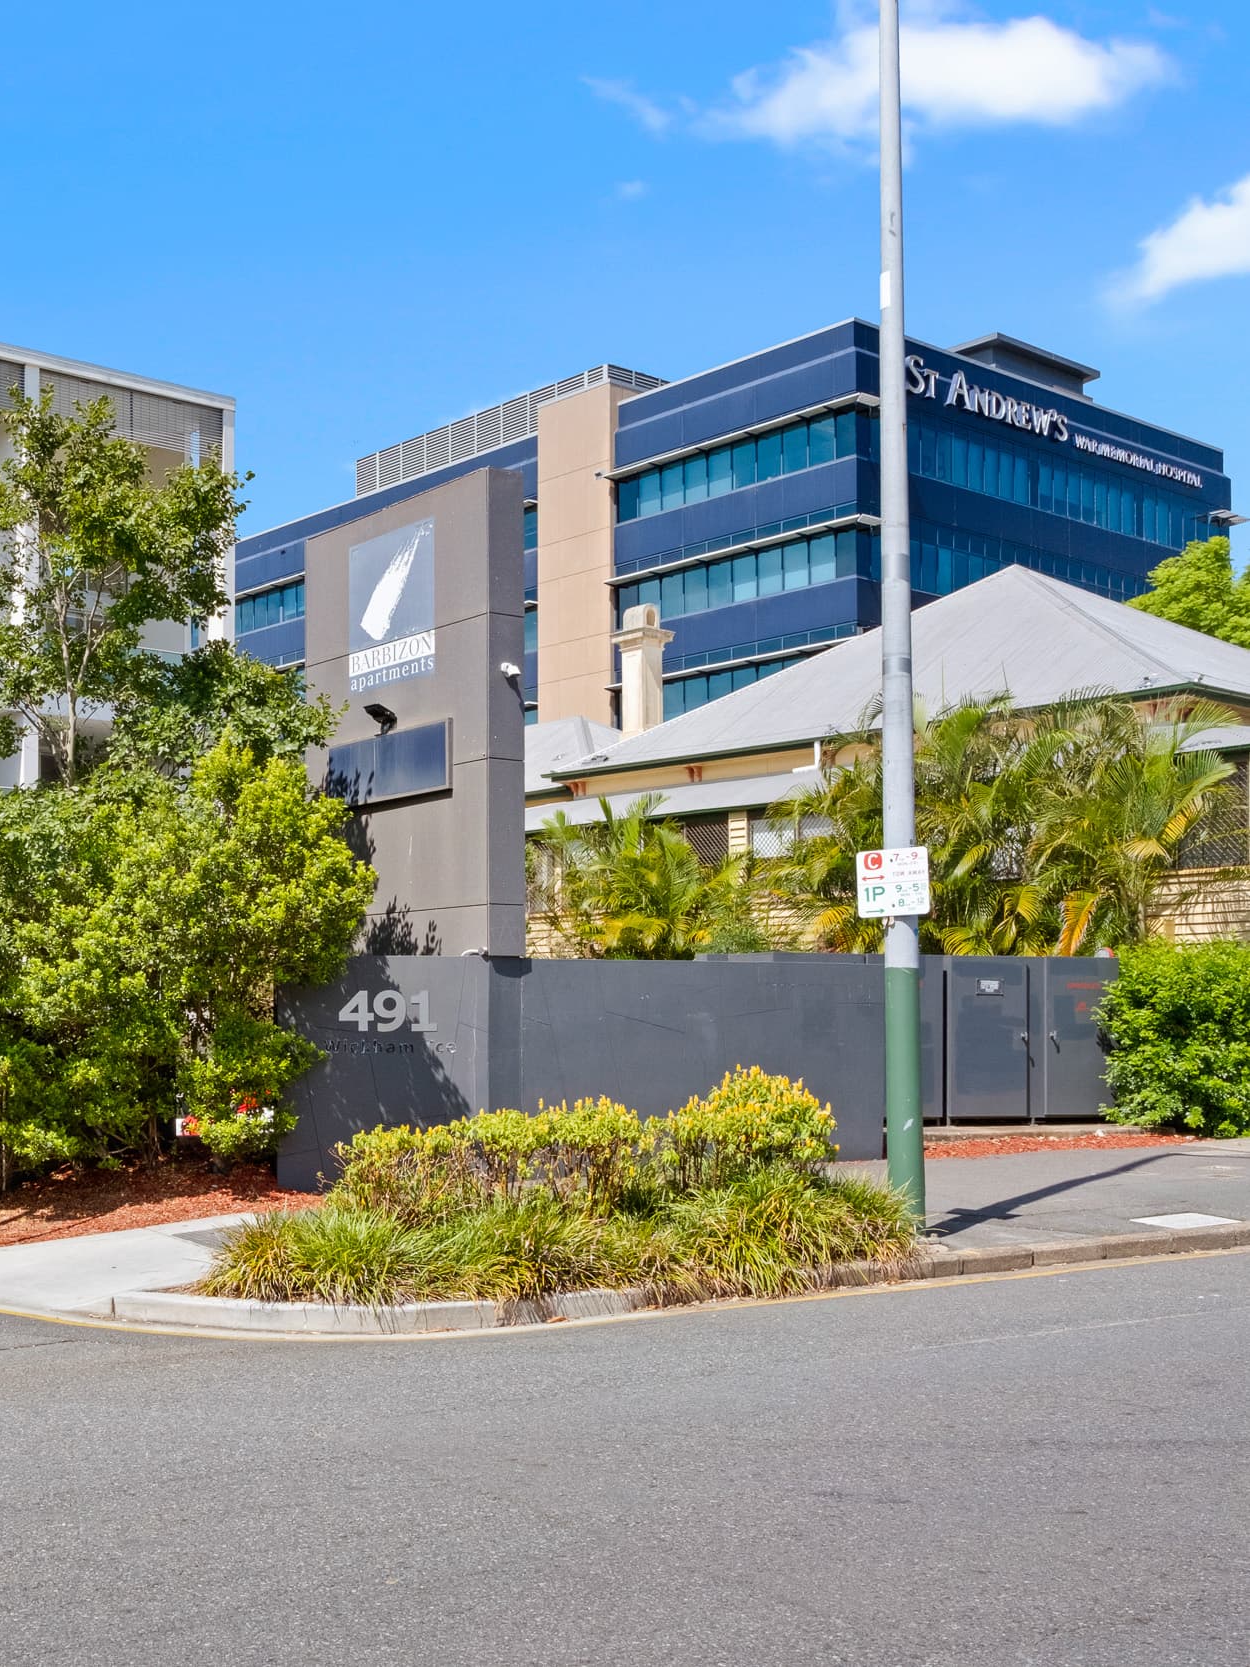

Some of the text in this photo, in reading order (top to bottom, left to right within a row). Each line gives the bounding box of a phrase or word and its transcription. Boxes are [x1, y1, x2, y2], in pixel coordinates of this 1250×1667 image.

[1074, 433, 1099, 453] WAR
[1155, 461, 1203, 488] HOSPITAL
[351, 630, 434, 674] BARBIZON
[350, 657, 435, 692] apartments
[866, 853, 879, 870] C
[864, 886, 885, 902] 1P
[338, 989, 438, 1032] 491
